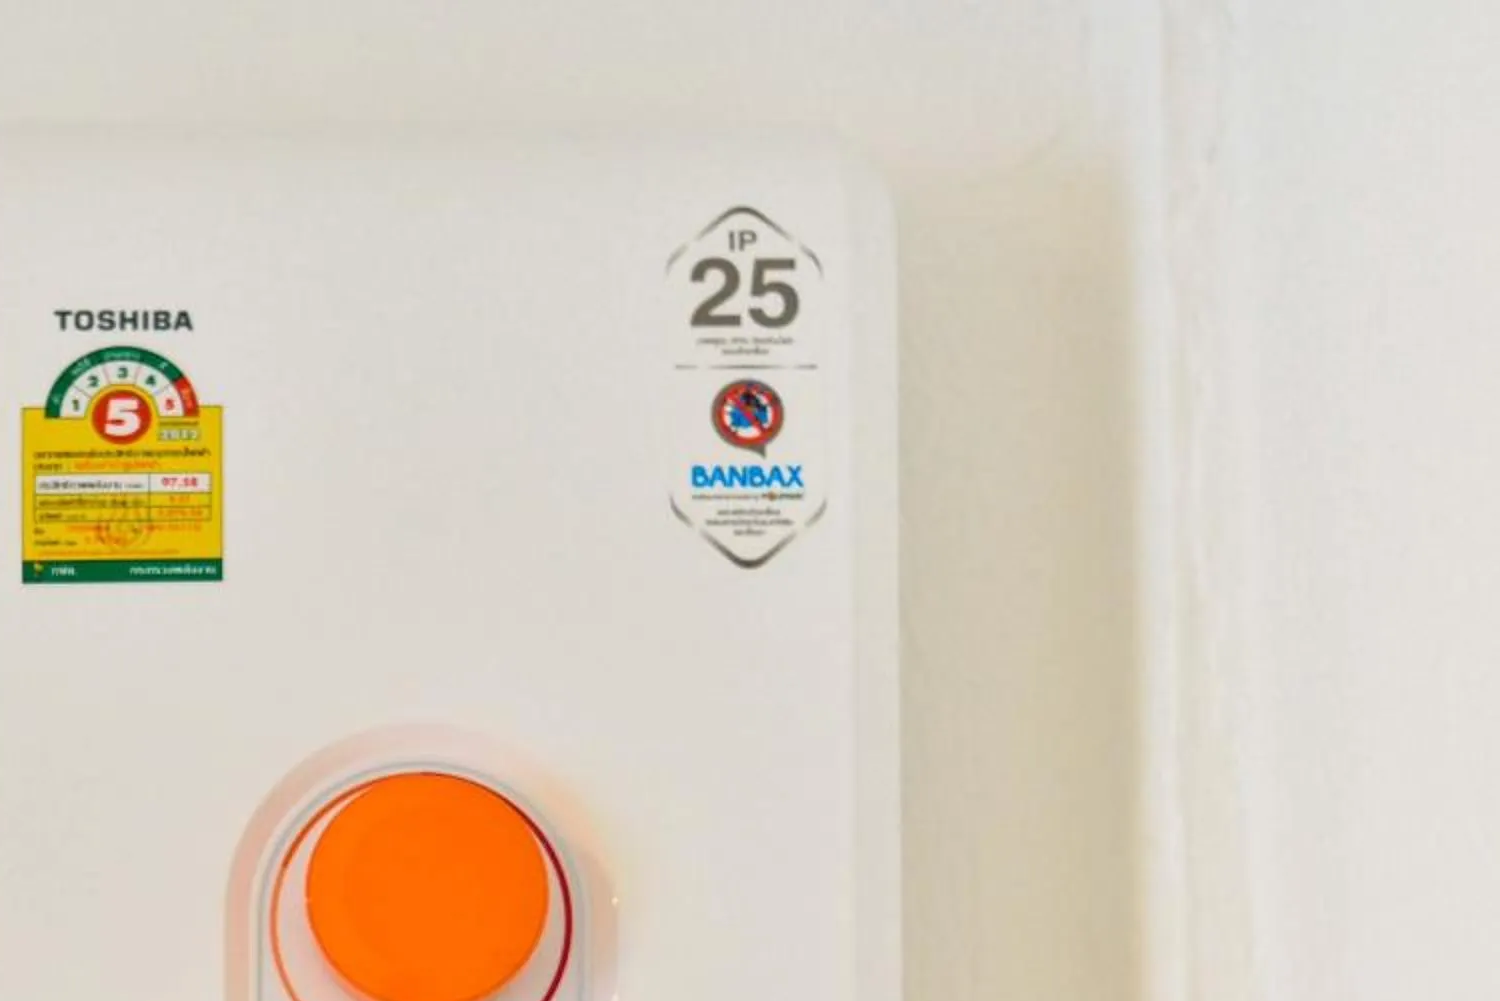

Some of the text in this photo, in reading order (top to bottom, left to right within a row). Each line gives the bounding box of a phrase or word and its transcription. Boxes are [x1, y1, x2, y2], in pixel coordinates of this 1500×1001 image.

[728, 230, 758, 252] IP
[690, 257, 800, 329] 25
[54, 310, 194, 331] TOSHIBA
[87, 375, 100, 388] 2
[117, 367, 129, 379] 3
[145, 375, 157, 387] 4
[104, 396, 141, 437] 5
[691, 465, 804, 488] BANBAX
